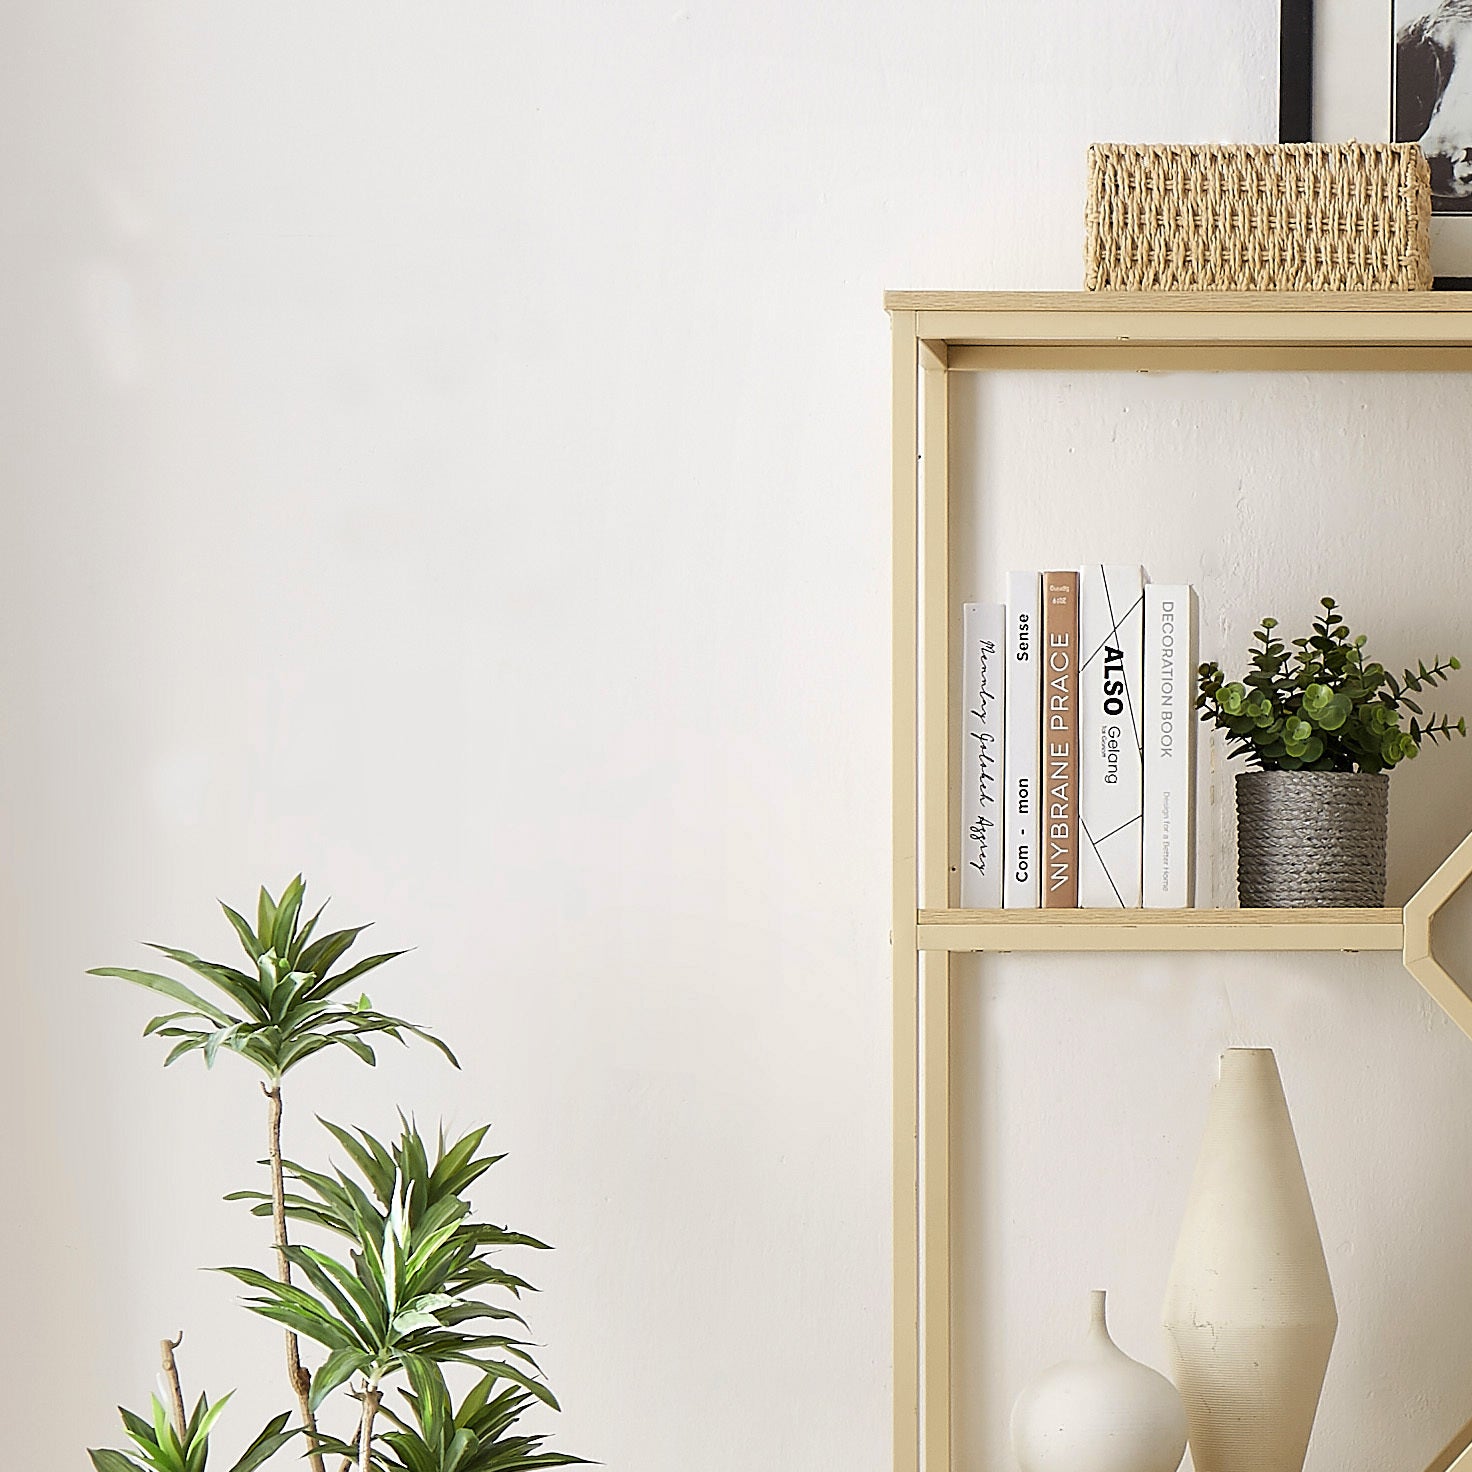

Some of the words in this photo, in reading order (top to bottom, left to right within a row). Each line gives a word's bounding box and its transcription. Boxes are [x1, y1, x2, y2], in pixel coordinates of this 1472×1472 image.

[1017, 614, 1029, 661] Sense
[1161, 601, 1174, 711] DECORATION
[1050, 632, 1070, 731] PRACE
[1103, 645, 1124, 716] ALSO
[1105, 725, 1121, 784] Gelang
[1161, 715, 1173, 758] BOOK
[1018, 778, 1029, 814] mon
[1050, 742, 1070, 891] WYBRANE
[1016, 845, 1029, 883] Com
[1162, 867, 1170, 892] Home
